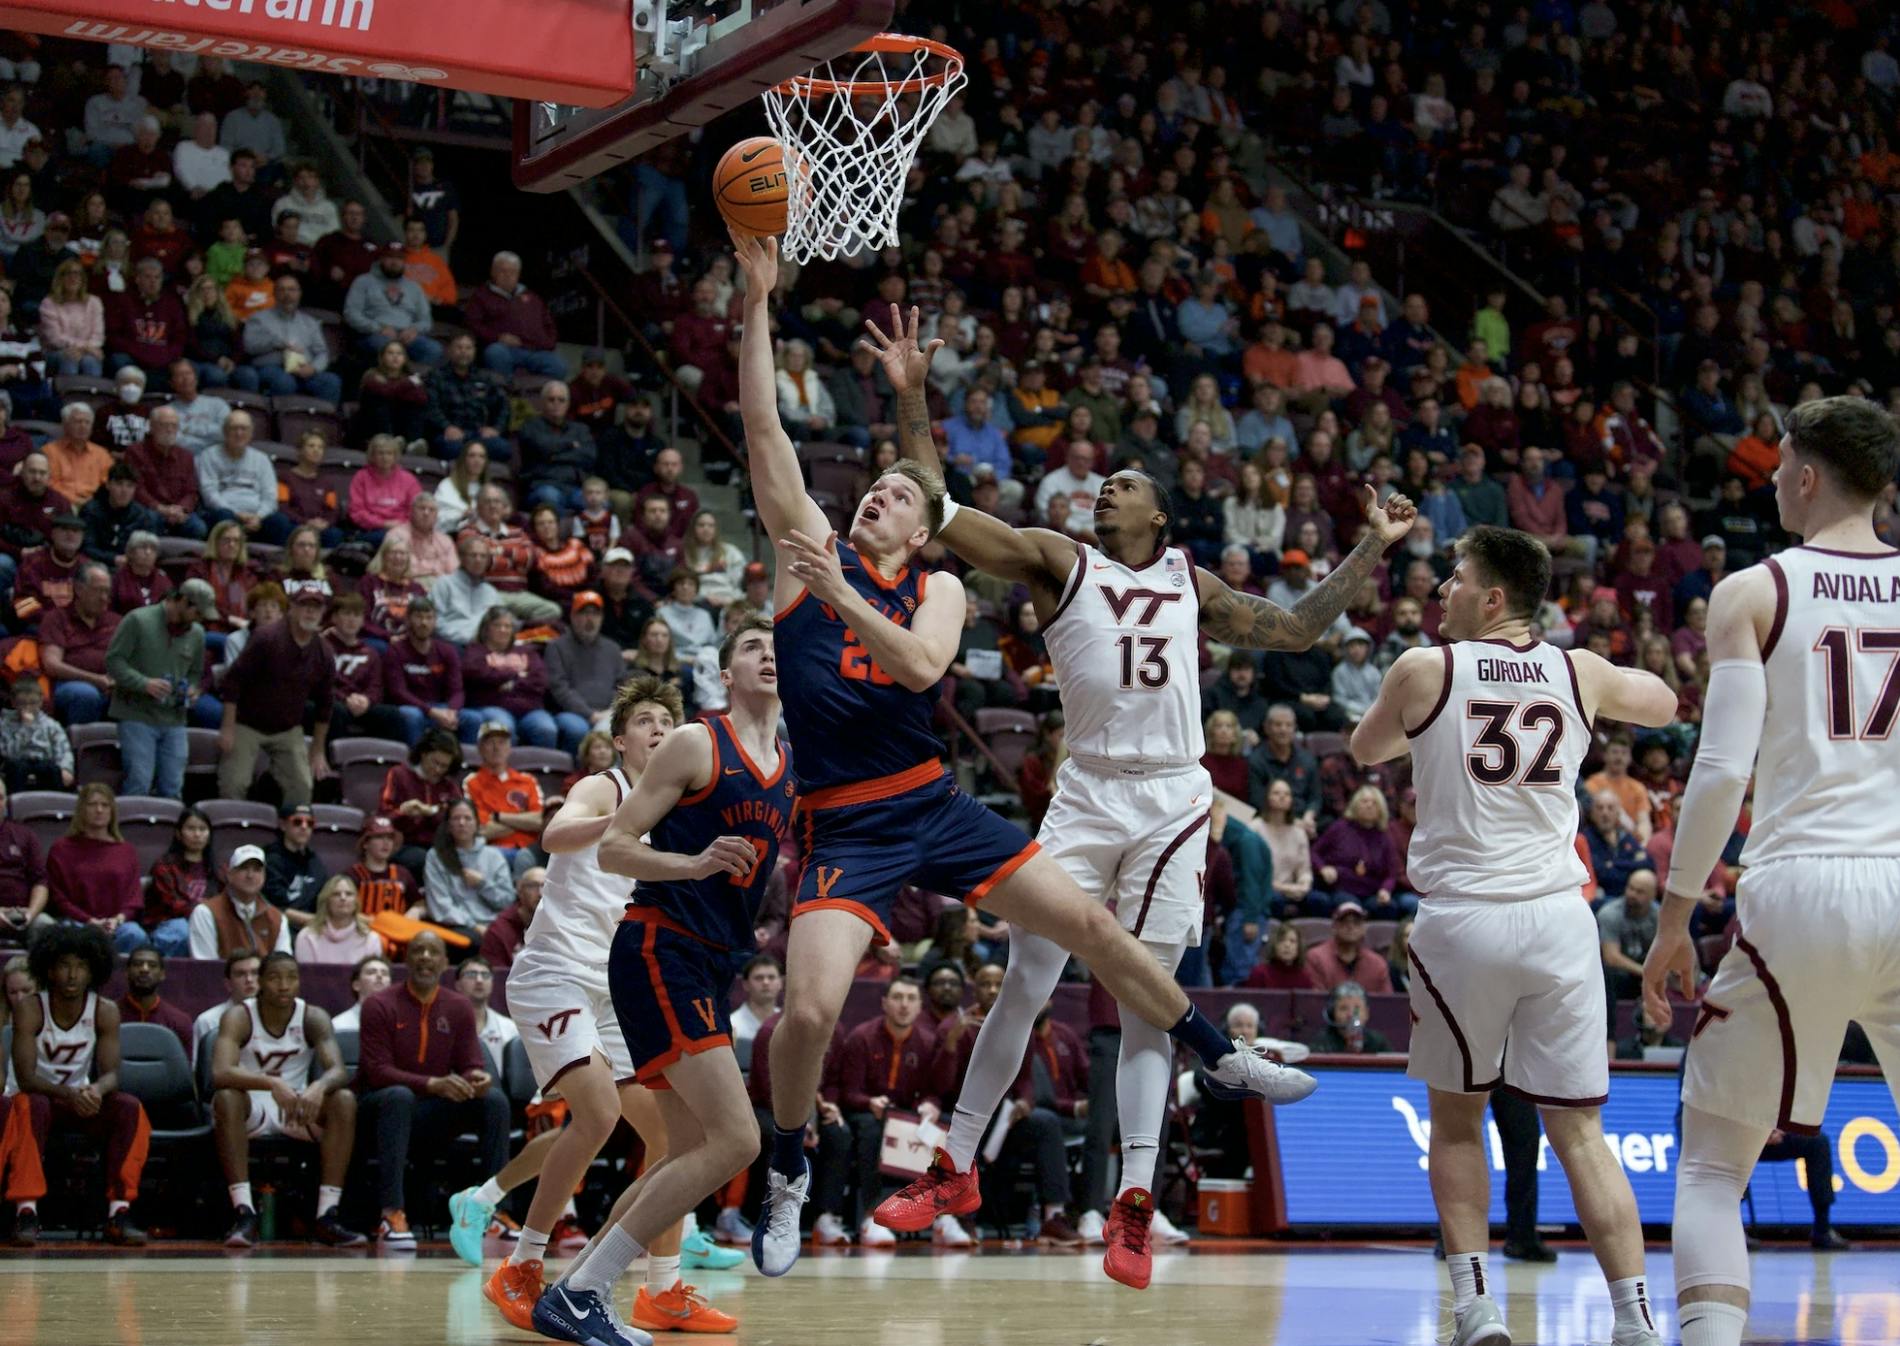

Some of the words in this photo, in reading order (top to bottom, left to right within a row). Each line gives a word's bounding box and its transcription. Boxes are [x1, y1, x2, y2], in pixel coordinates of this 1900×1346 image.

[749, 171, 788, 192] ELIT
[1096, 584, 1182, 627] VT
[1115, 634, 1173, 690] 13
[1477, 658, 1549, 683] GURDAK
[1812, 625, 1900, 740] 17
[1467, 700, 1564, 785] 32
[816, 866, 845, 897] V
[537, 1008, 582, 1042] VT
[691, 998, 718, 1032] V
[43, 1039, 88, 1065] VT
[253, 1048, 300, 1070] VT
